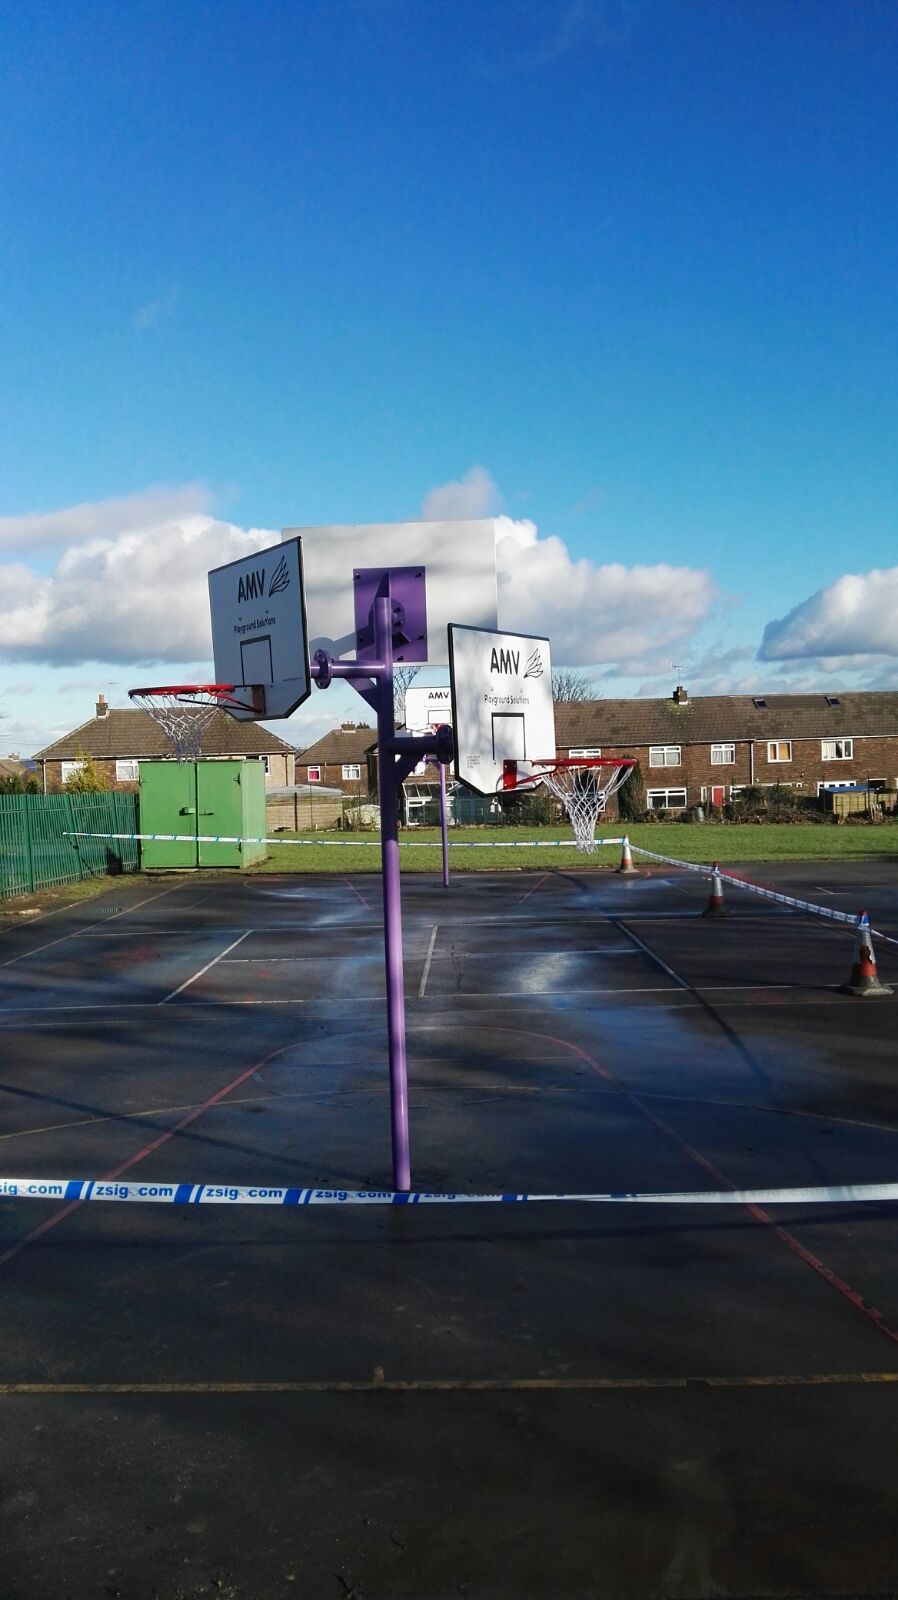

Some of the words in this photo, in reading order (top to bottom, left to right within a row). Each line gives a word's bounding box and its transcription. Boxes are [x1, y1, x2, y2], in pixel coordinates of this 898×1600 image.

[238, 568, 265, 604] AMV
[233, 619, 256, 634] Playground
[256, 616, 276, 628] Solutions
[490, 647, 520, 675] AMV
[428, 691, 449, 699] AMV
[484, 694, 509, 706] Playground
[510, 695, 530, 705] Solutions
